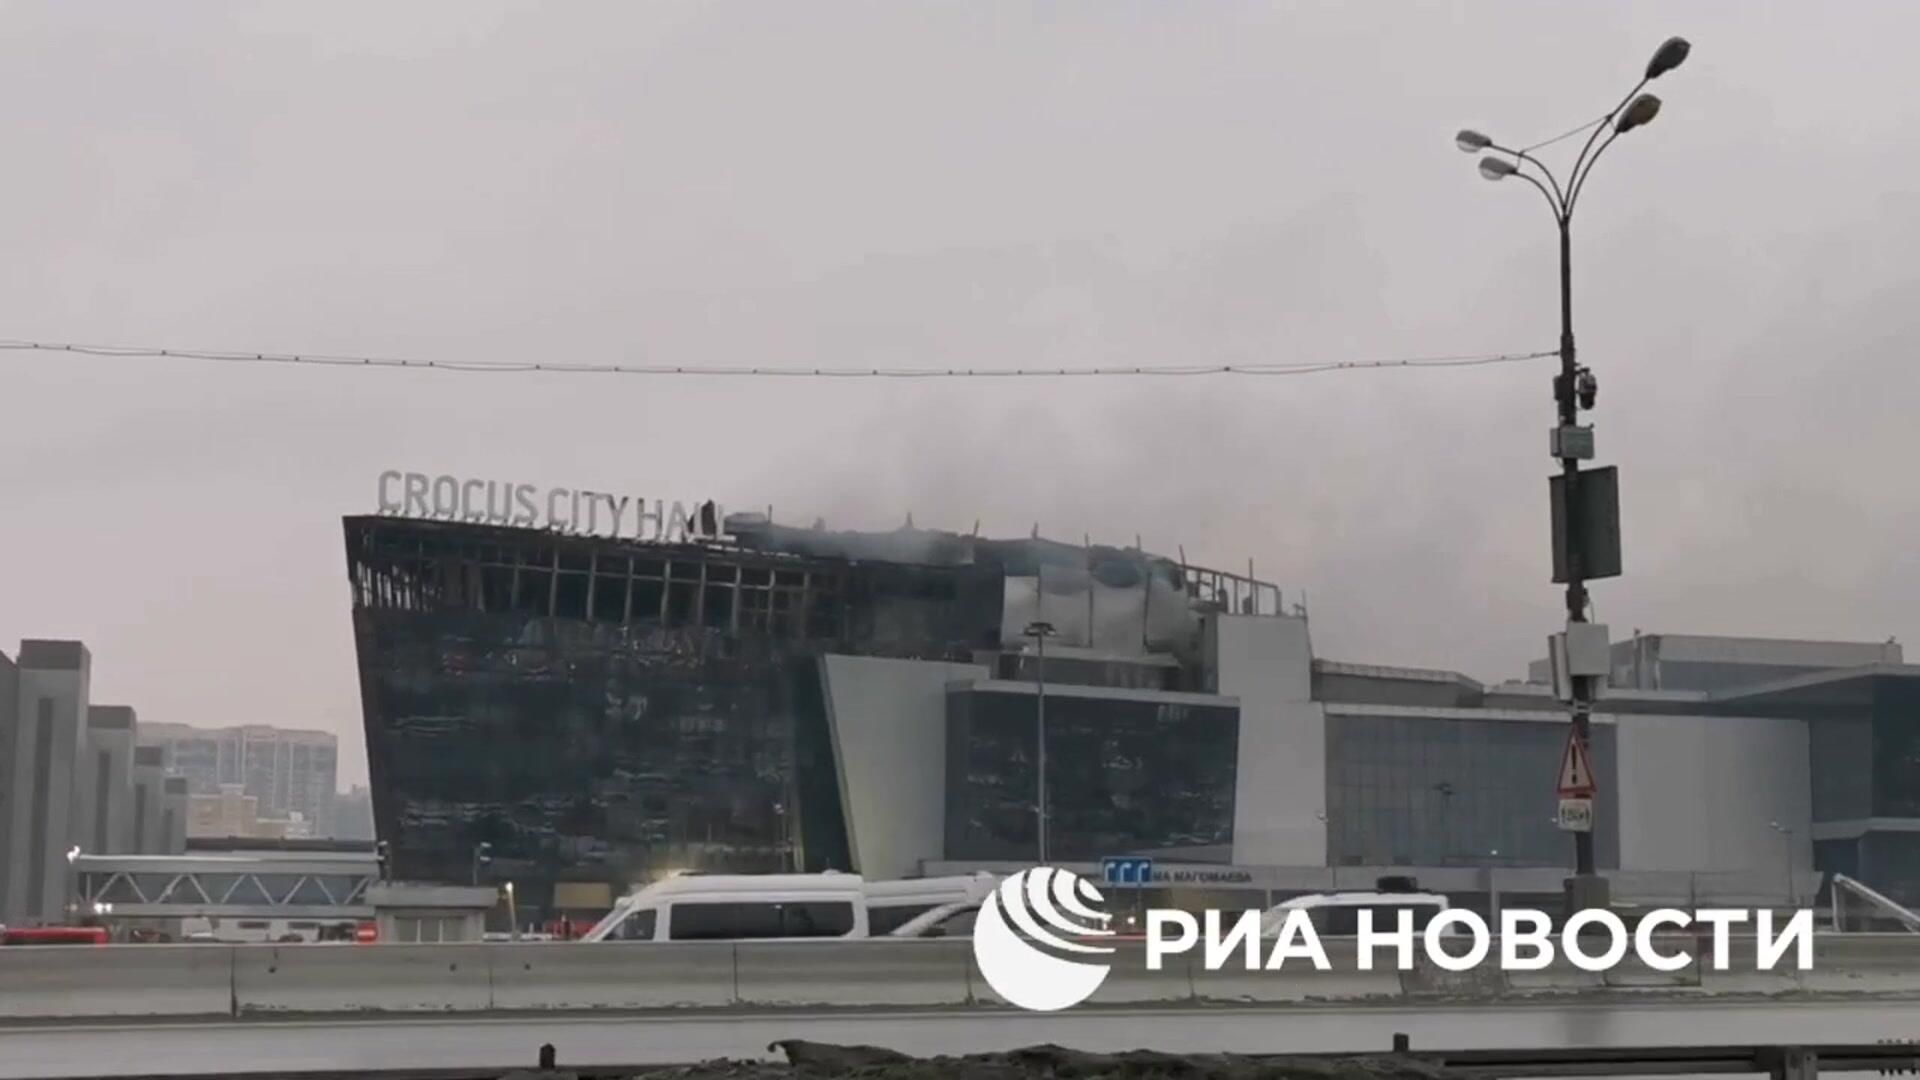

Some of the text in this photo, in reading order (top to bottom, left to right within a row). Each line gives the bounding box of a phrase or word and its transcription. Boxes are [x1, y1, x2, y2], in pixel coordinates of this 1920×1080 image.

[378, 470, 736, 543] CROCUS CITY HALL
